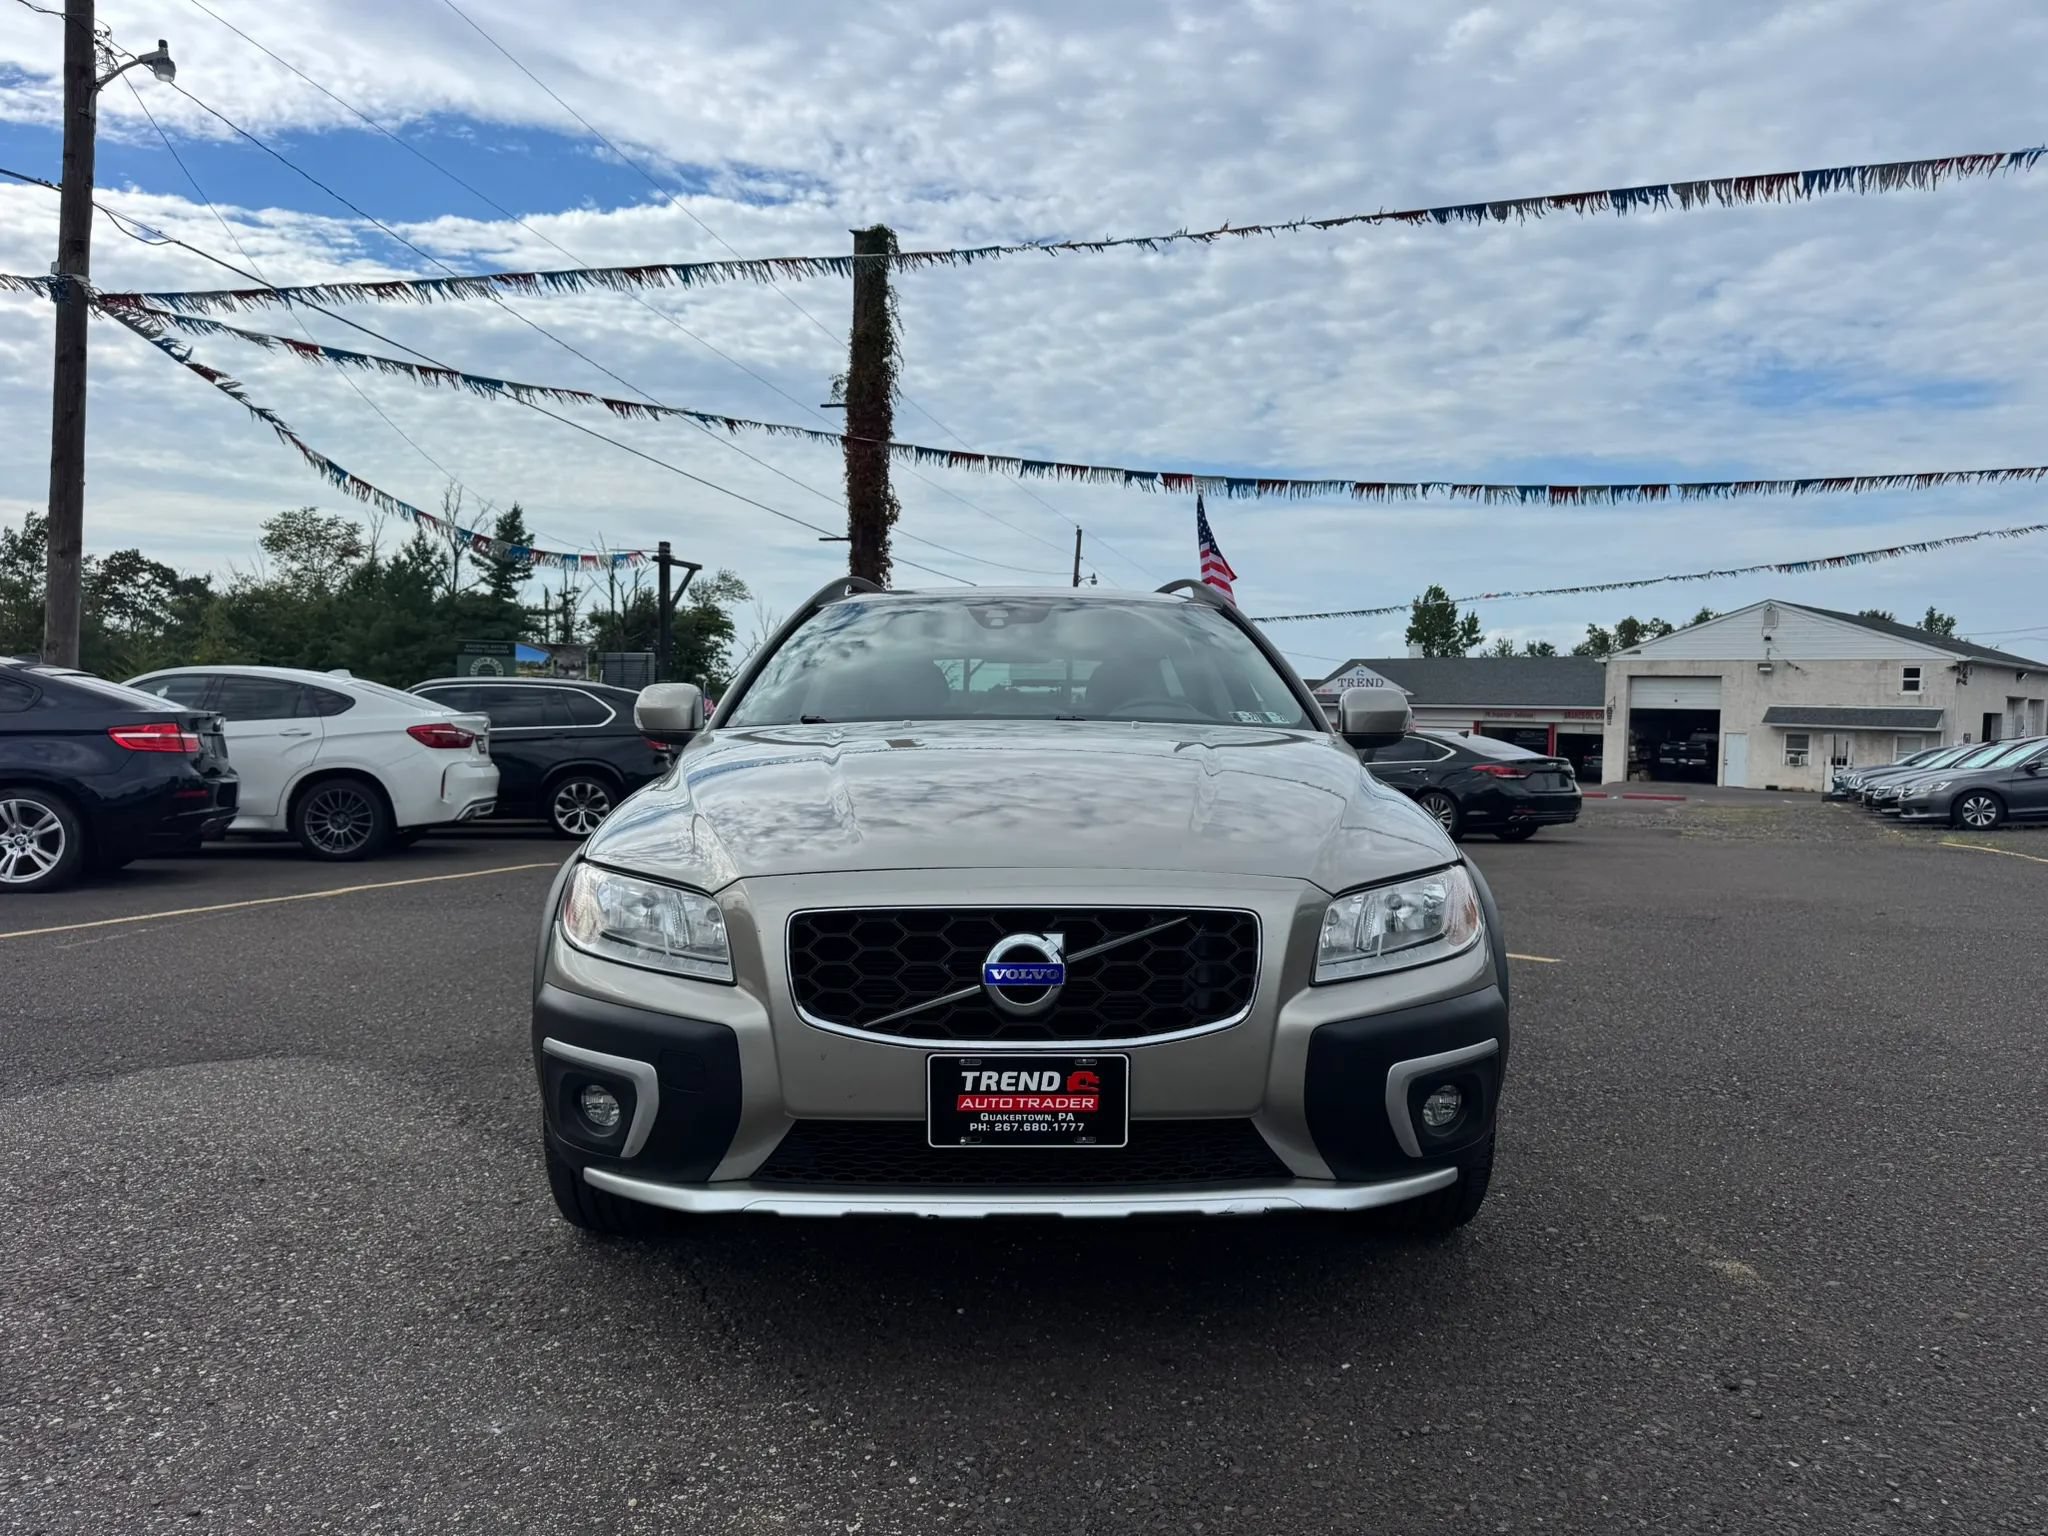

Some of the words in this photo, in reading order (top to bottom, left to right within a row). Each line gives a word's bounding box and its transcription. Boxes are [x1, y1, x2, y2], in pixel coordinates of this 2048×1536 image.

[1337, 678, 1384, 688] TREND
[989, 968, 1060, 980] VOLVO
[961, 1071, 1061, 1091] TREND
[1058, 1112, 1075, 1121] PA
[969, 1122, 990, 1132] PH:
[994, 1122, 1085, 1132] 267.680.1777
